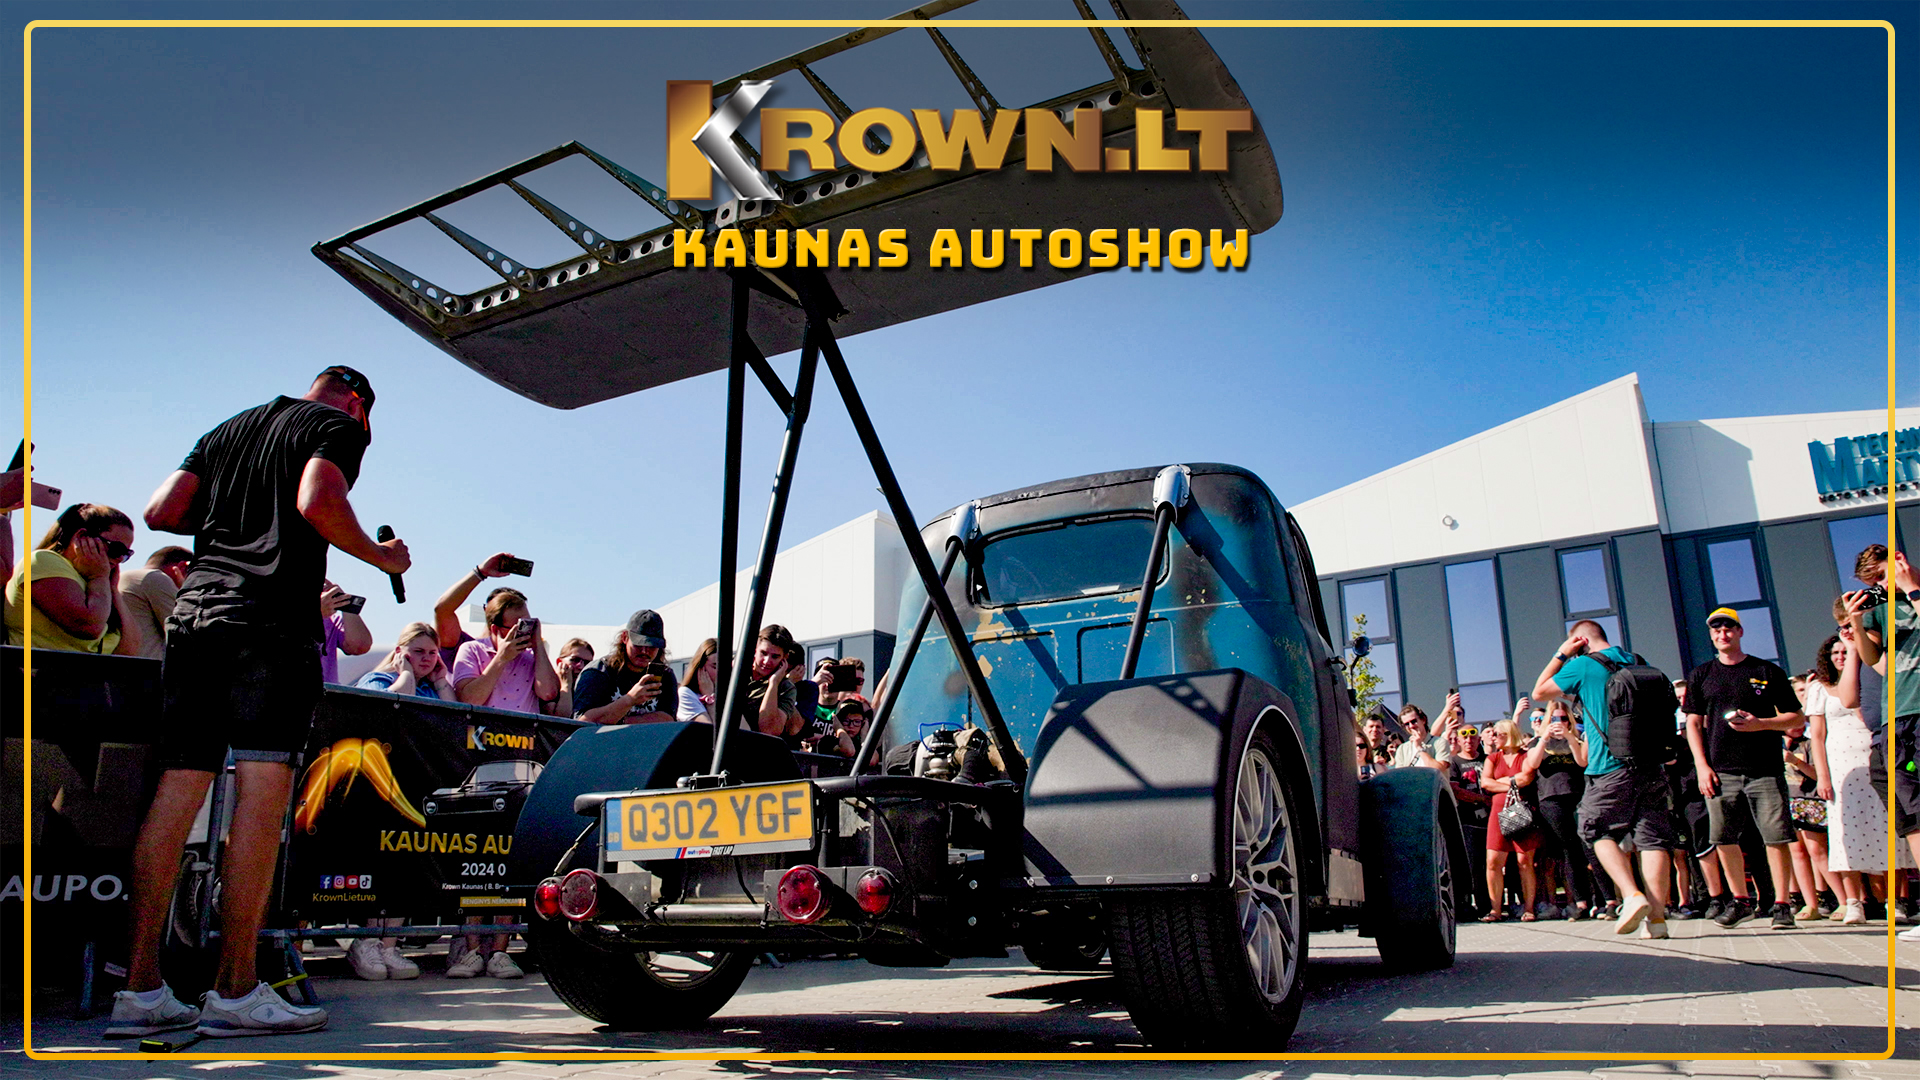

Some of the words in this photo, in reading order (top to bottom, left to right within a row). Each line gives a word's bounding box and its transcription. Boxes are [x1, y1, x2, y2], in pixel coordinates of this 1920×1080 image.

[467, 725, 535, 751] KROWN
[628, 798, 719, 843] Q302
[730, 790, 804, 837] YGF
[380, 830, 478, 854] KAUNAS
[482, 834, 513, 855] AU
[607, 832, 620, 843] GB
[461, 862, 495, 877] 2024
[312, 892, 377, 902] KrownLietuva
